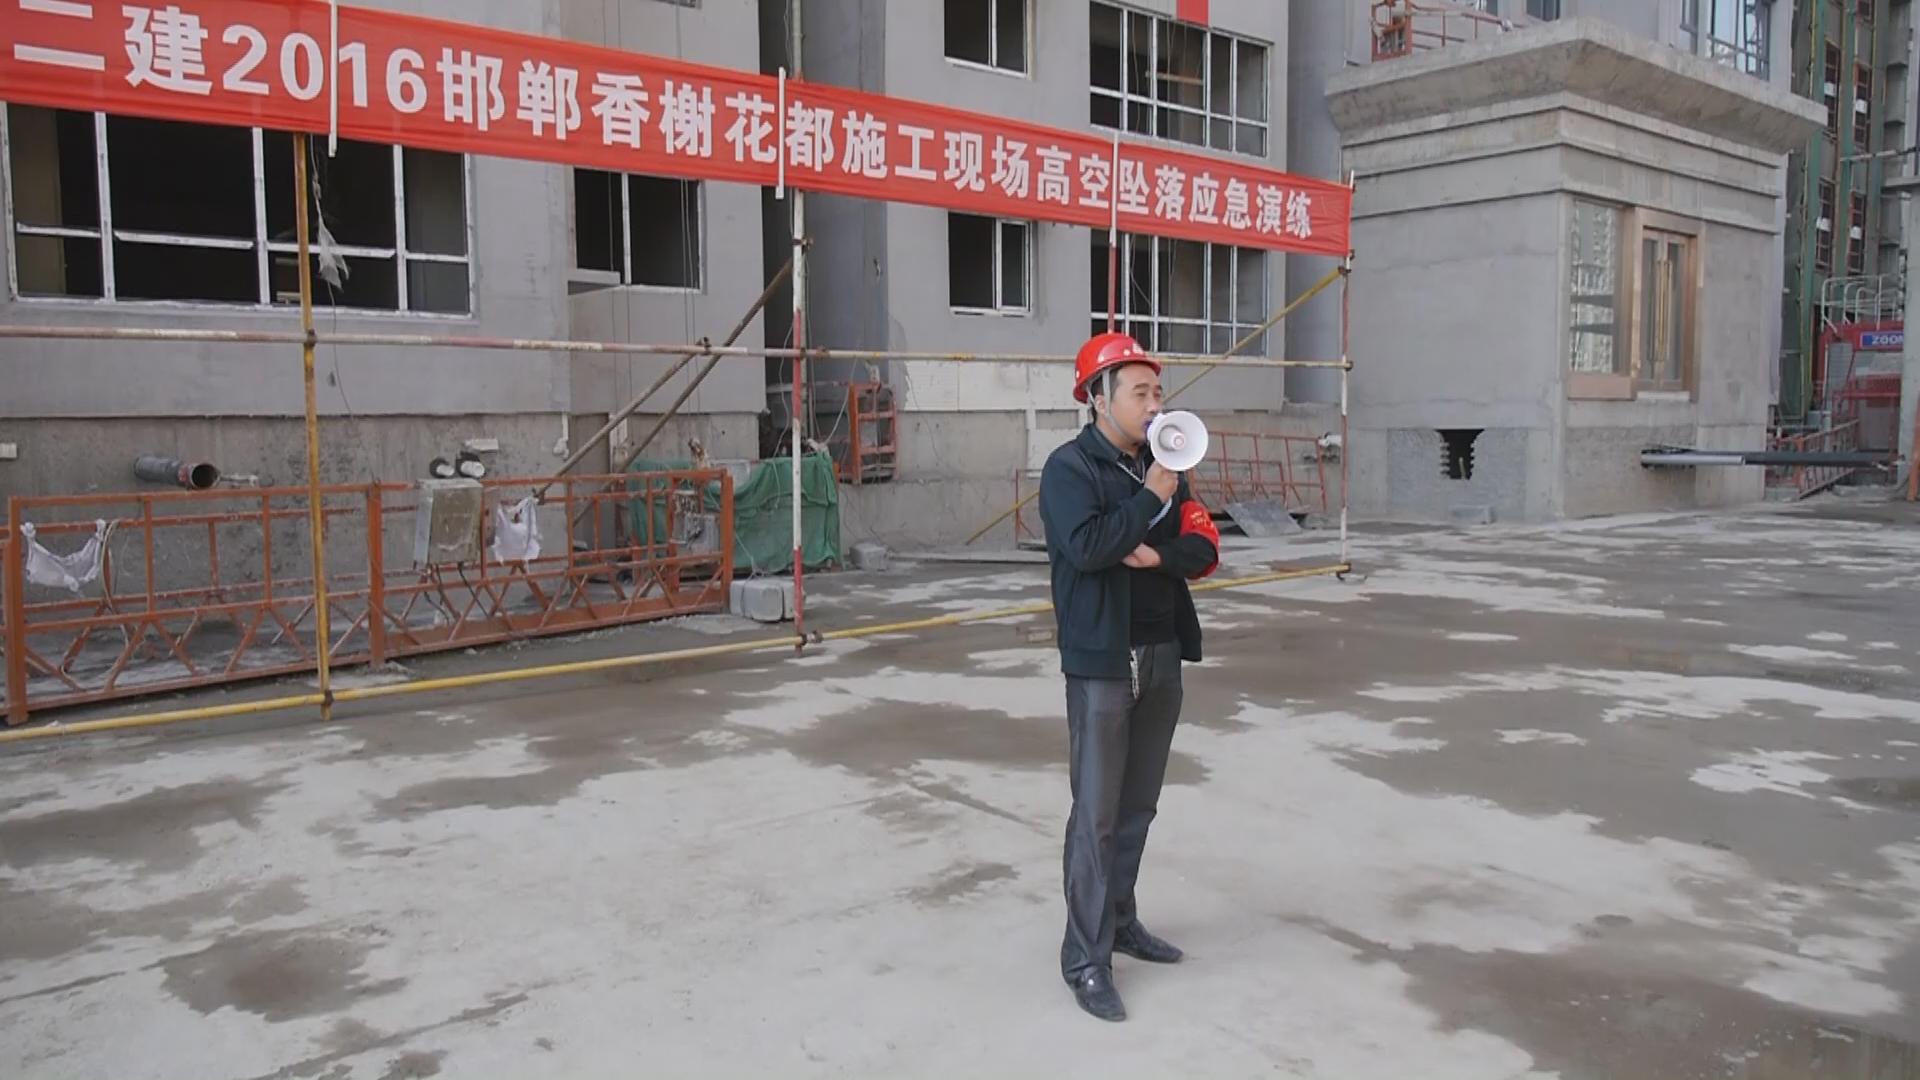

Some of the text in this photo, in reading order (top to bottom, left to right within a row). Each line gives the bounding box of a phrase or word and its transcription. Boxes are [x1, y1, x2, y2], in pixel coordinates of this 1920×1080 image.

[14, 0, 1312, 239] 二建2016邯郸香榭花都施工现场高空坠落应急演练
